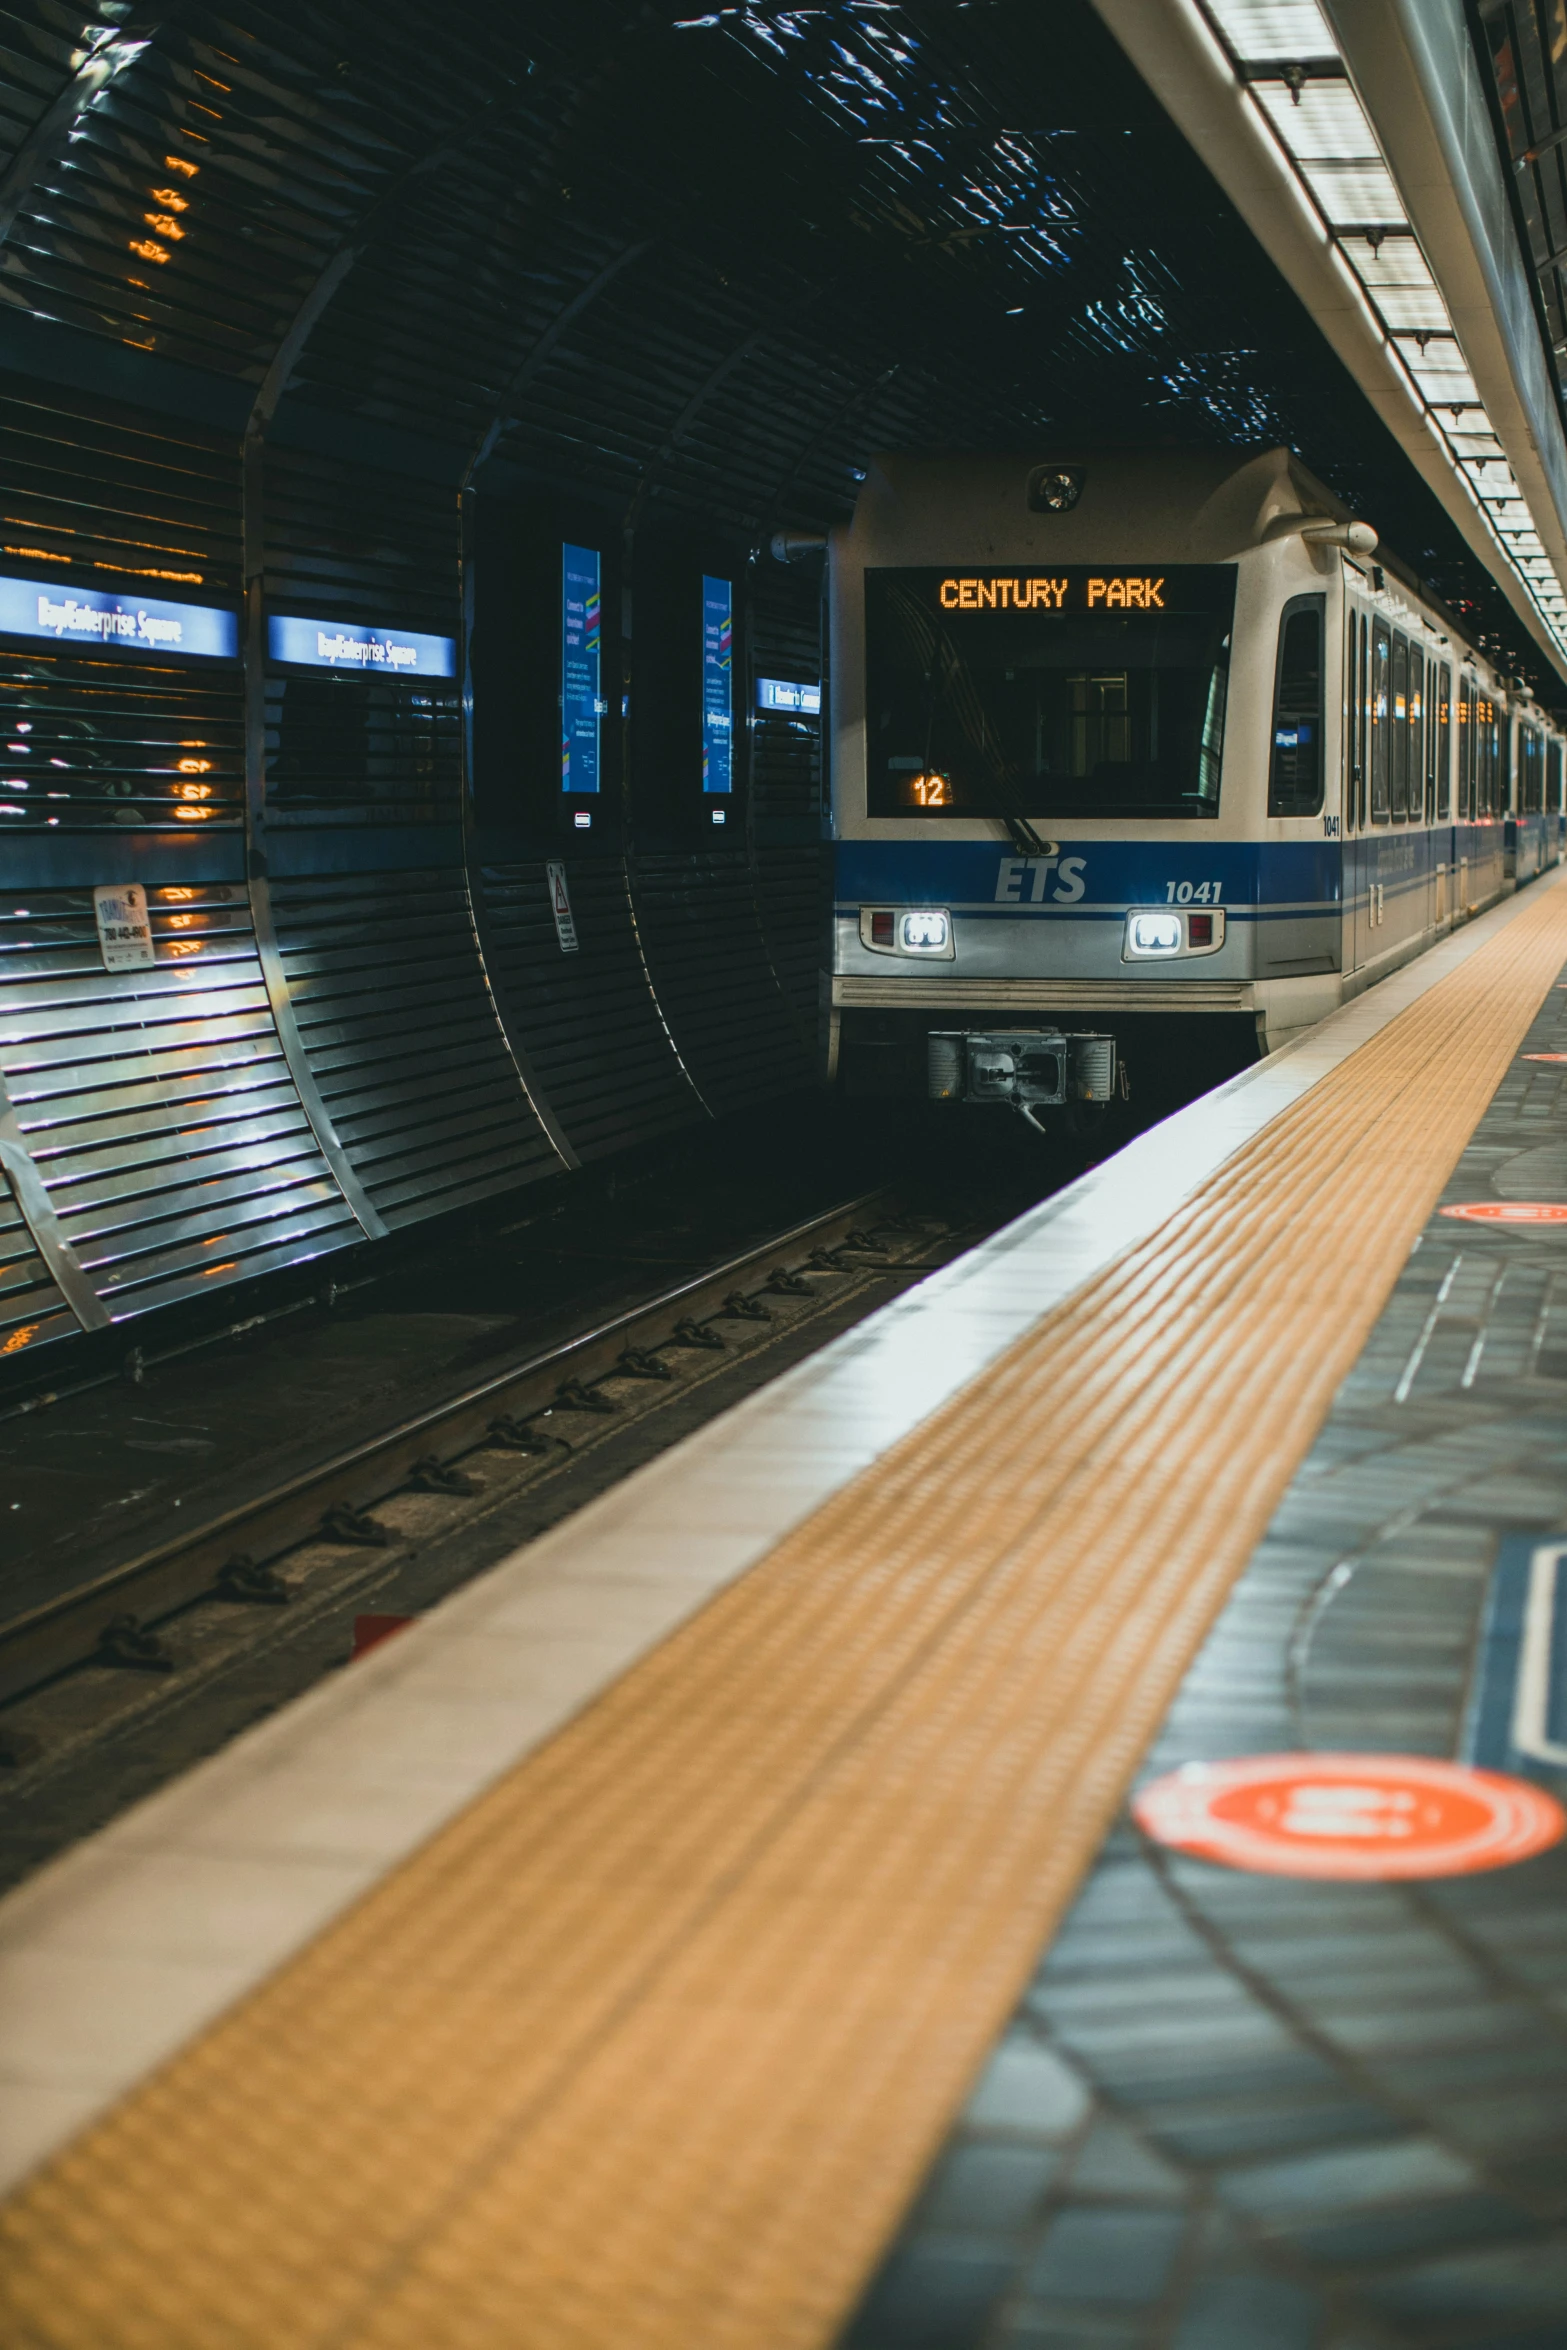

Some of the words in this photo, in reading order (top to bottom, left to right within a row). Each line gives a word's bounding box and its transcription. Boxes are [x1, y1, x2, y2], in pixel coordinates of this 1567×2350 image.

[940, 578, 1068, 608] CENTURY
[1087, 578, 1165, 607] PARK
[914, 776, 943, 805] 12
[1324, 816, 1340, 837] 1041
[995, 857, 1087, 903] ETS
[1166, 881, 1222, 904] 1041
